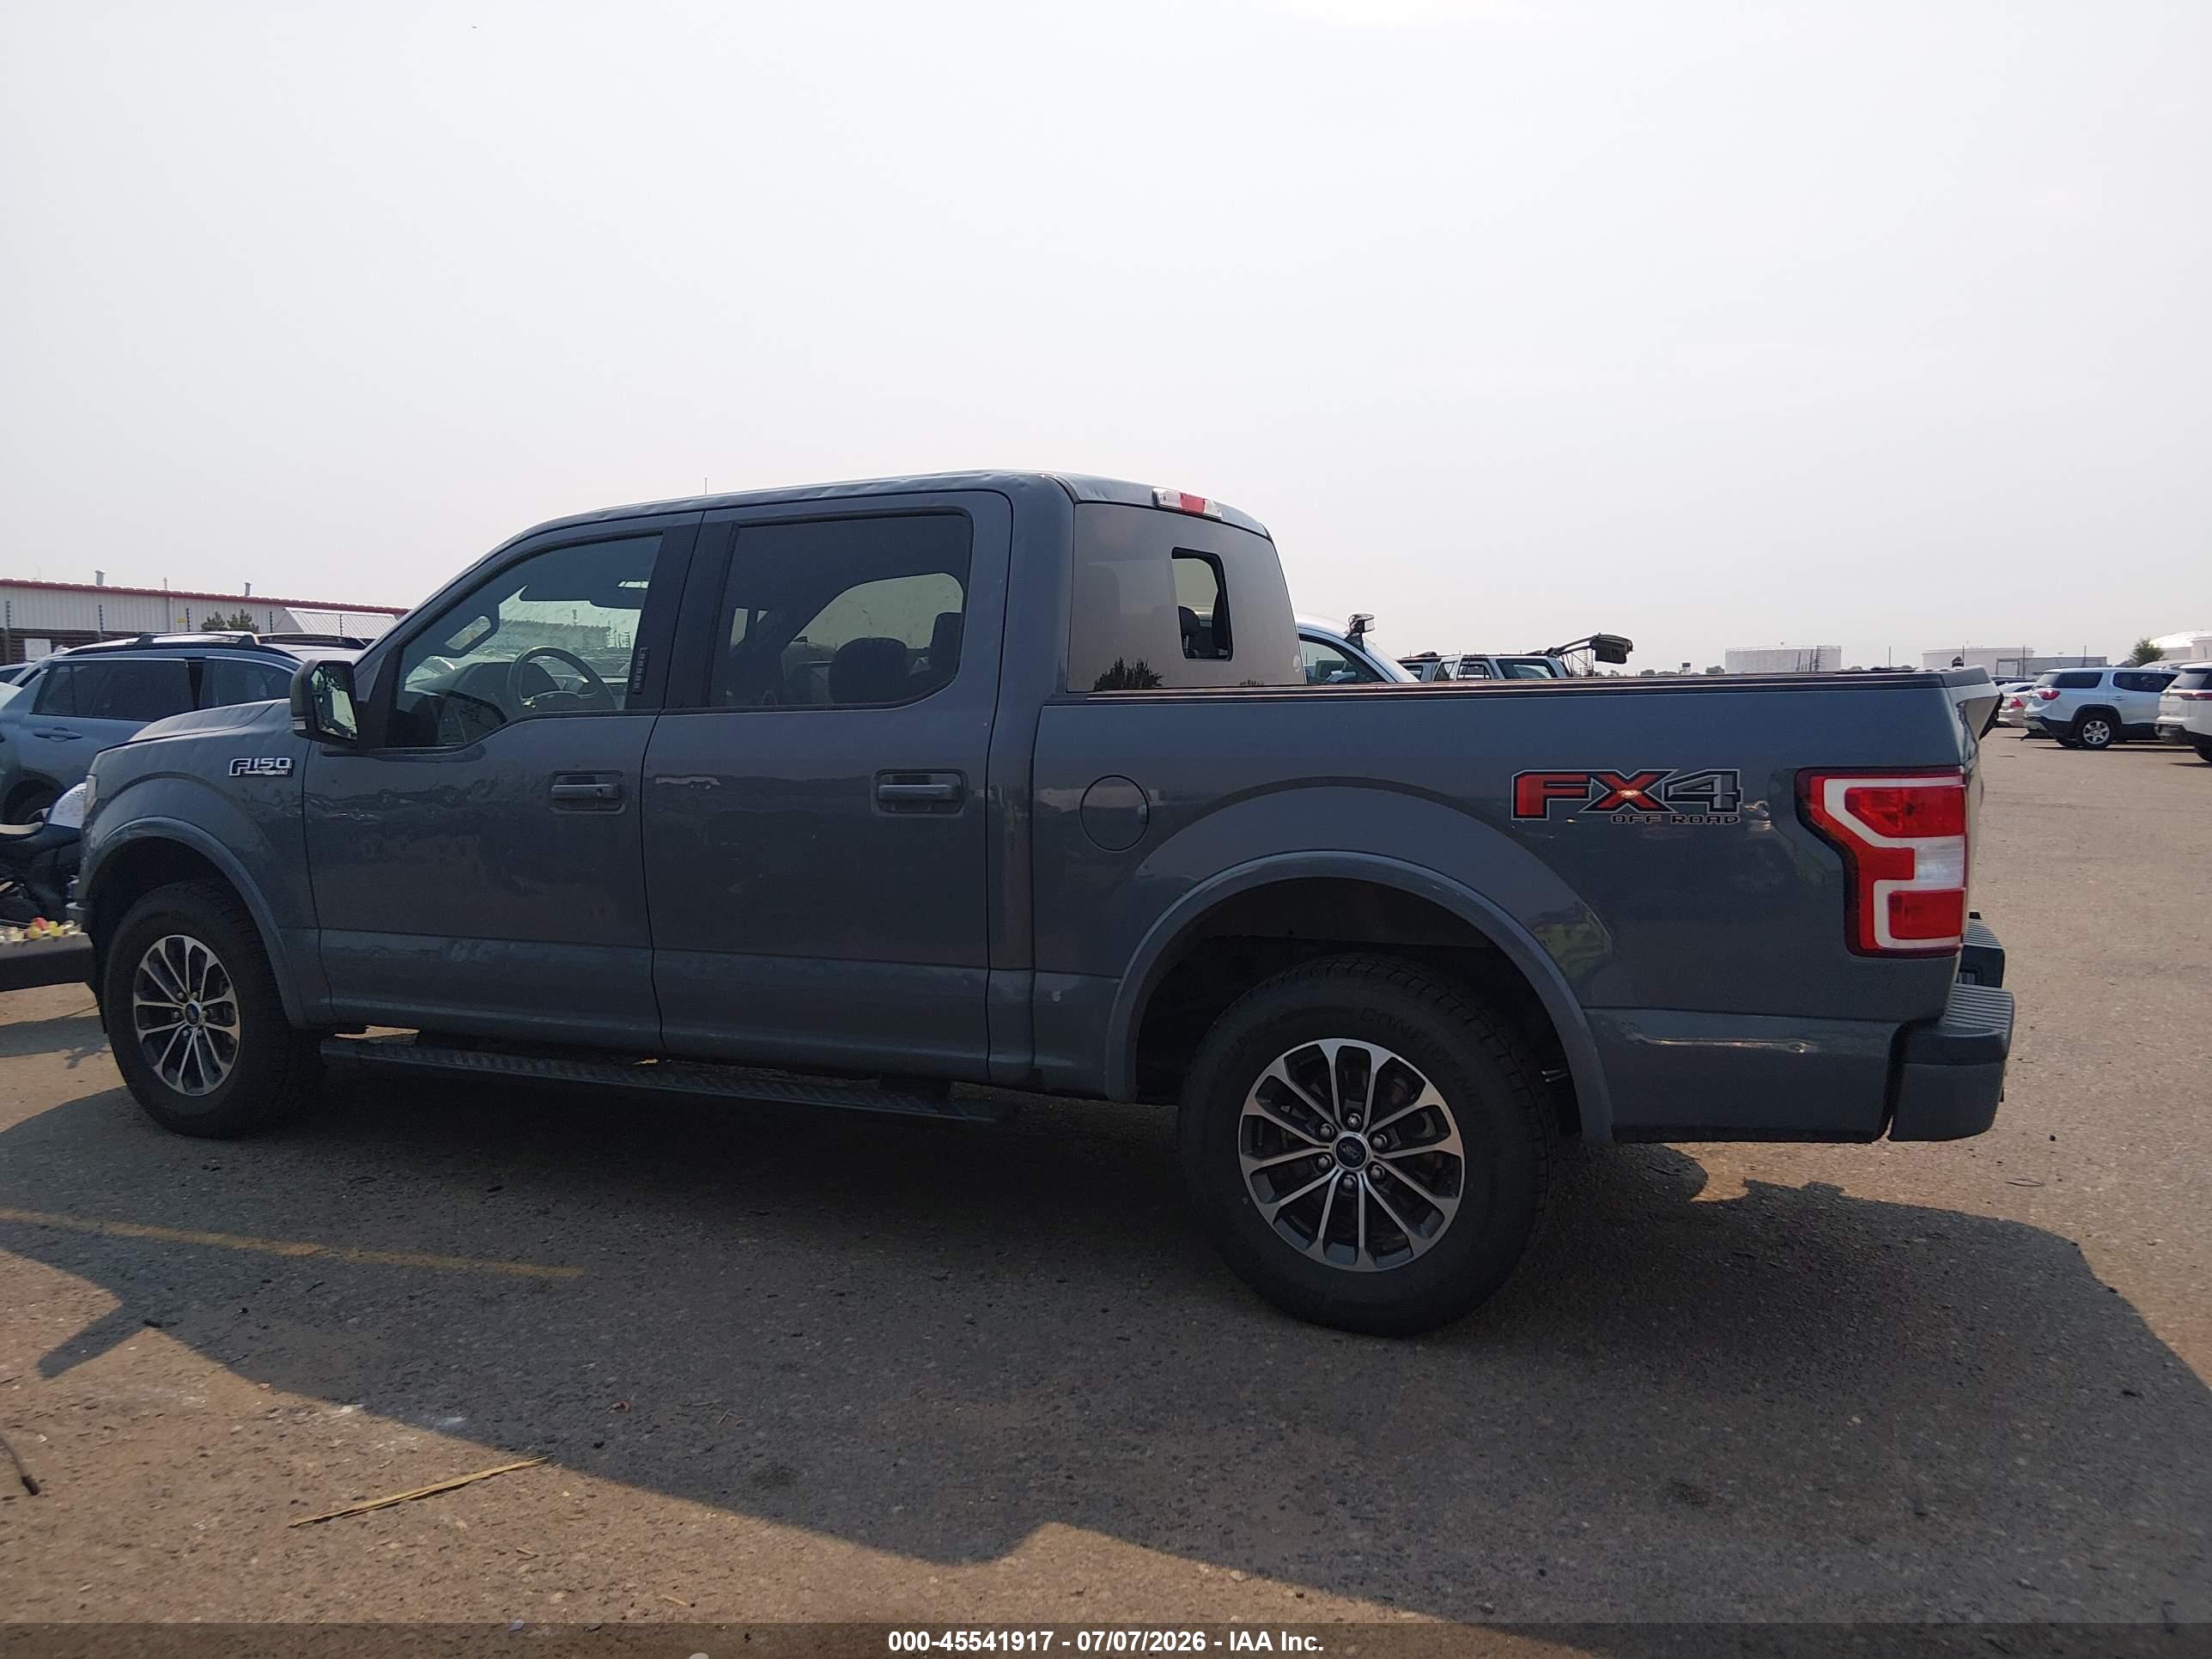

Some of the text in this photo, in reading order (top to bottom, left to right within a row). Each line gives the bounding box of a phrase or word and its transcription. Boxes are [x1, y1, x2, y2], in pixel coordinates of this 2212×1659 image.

[1511, 769, 1743, 820] FX4
[1609, 814, 1740, 824] OFF ROAD
